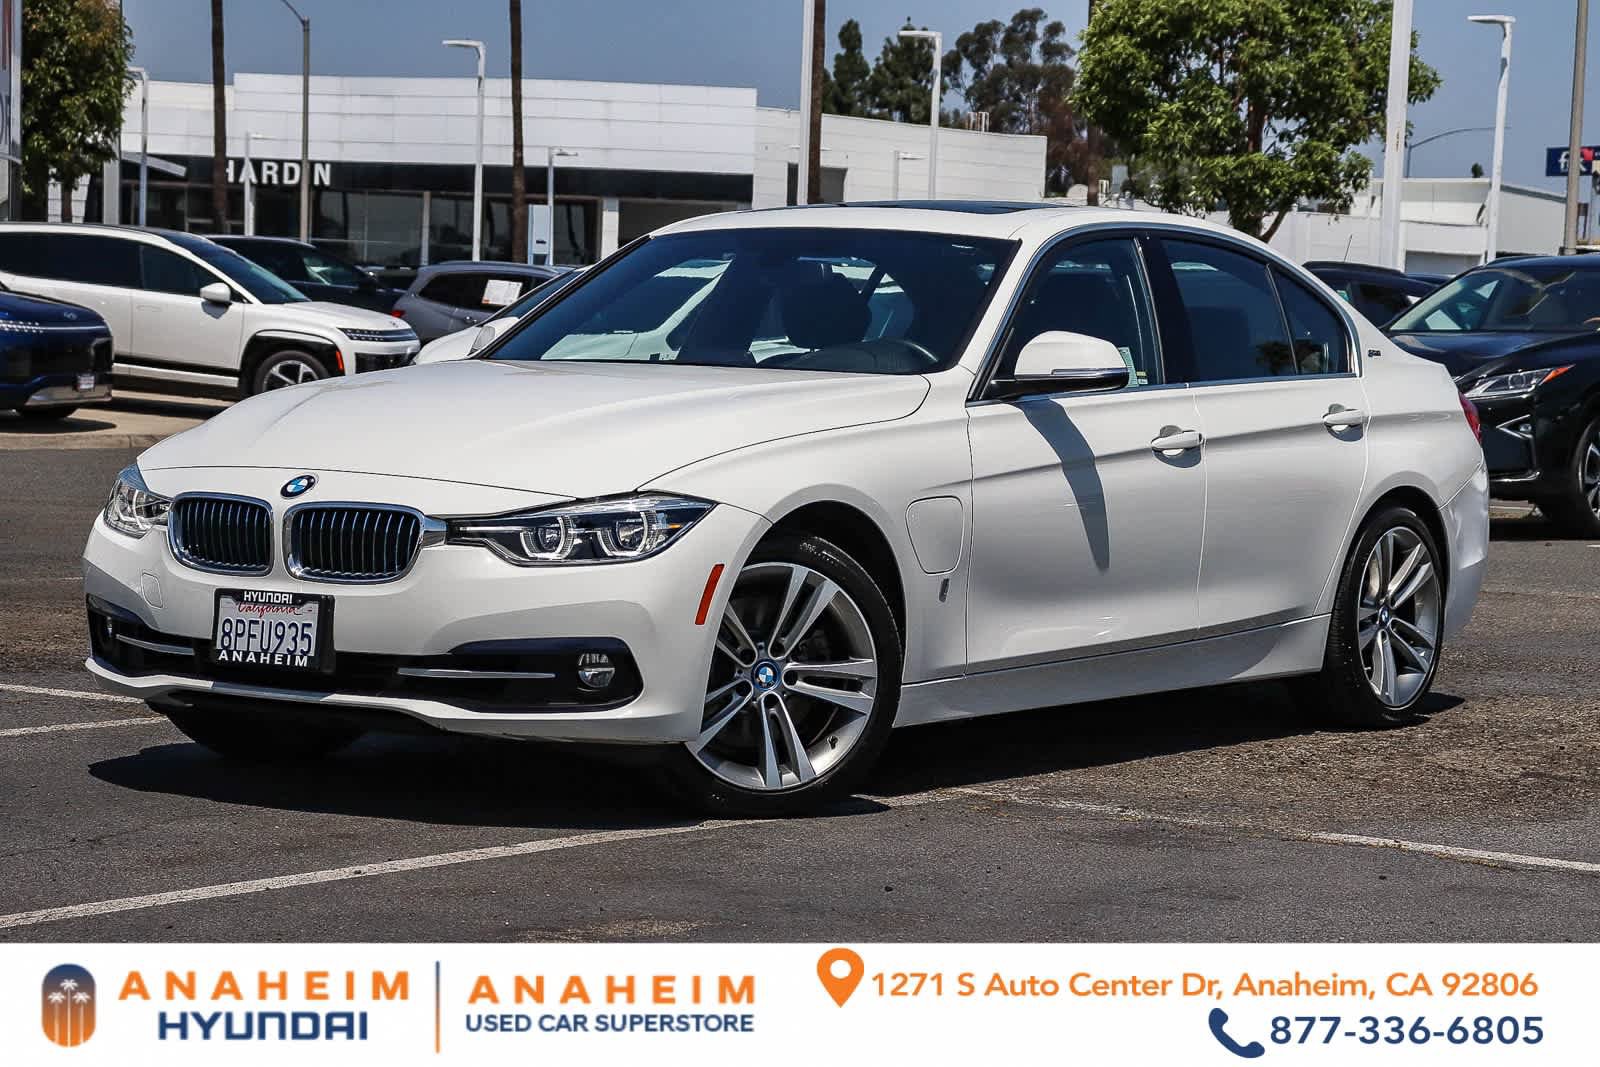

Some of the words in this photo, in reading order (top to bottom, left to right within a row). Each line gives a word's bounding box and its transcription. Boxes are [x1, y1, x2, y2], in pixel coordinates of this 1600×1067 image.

[225, 159, 332, 187] HARDN
[244, 591, 293, 604] HYUNDAI
[238, 602, 301, 617] California
[221, 618, 312, 656] 8PFU935
[218, 650, 308, 667] ANAHEIM
